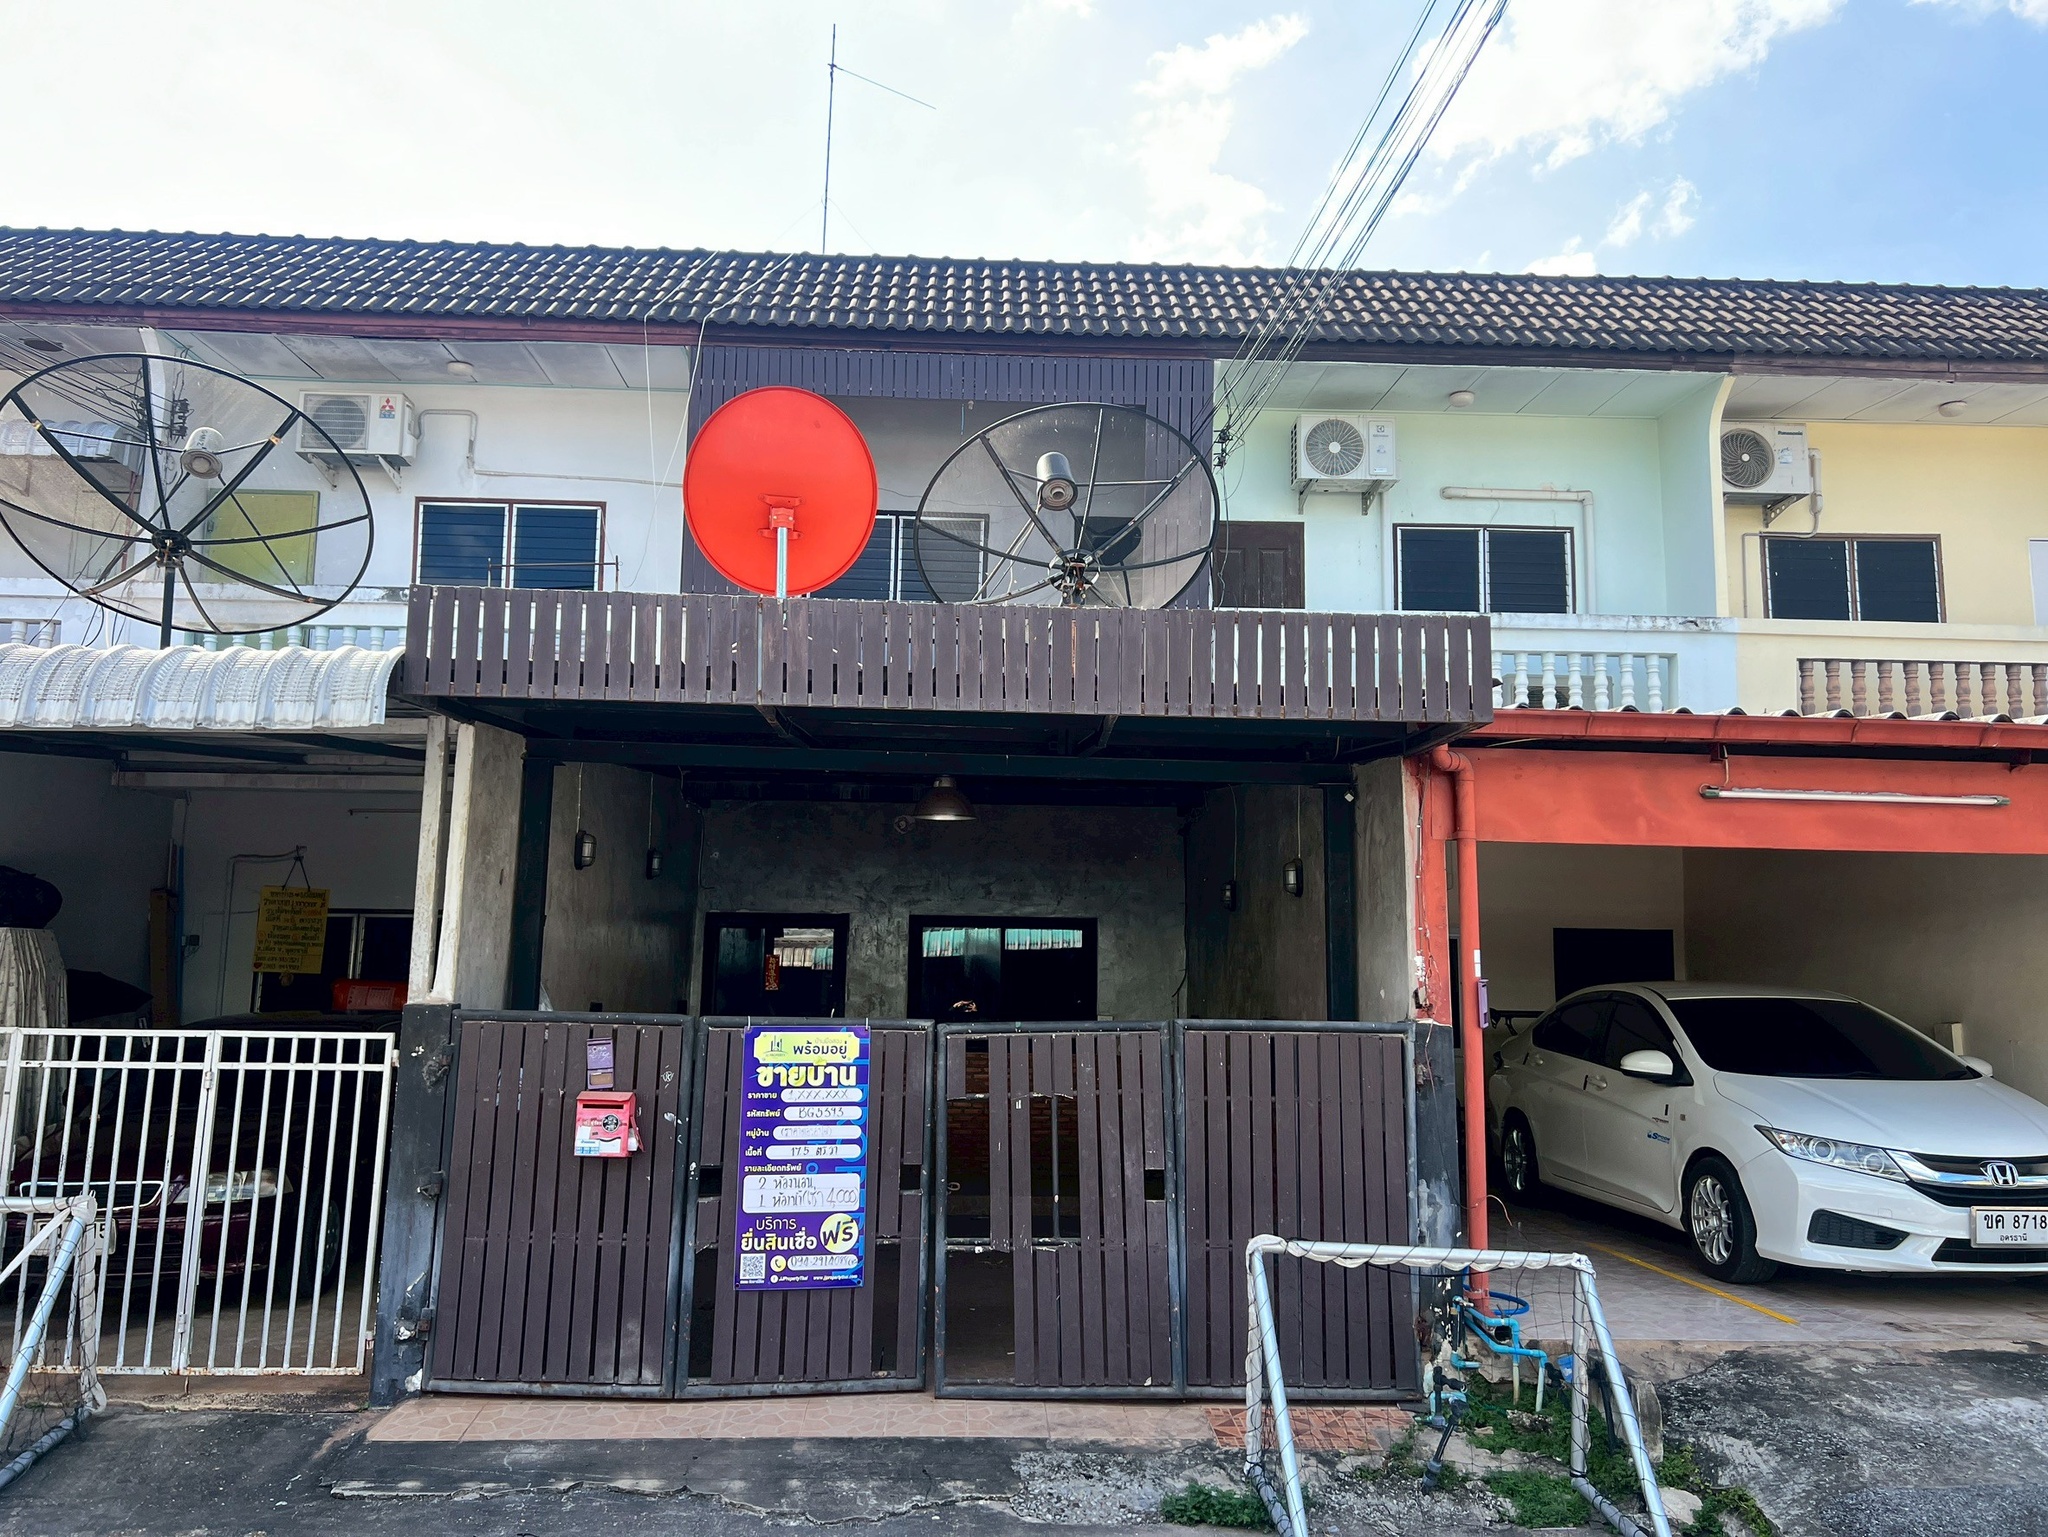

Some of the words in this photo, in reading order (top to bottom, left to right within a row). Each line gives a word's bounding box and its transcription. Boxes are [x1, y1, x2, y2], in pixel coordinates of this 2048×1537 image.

[793, 1040, 847, 1060] พร้อมอยู่
[756, 1057, 857, 1087] ขายบ้าน
[746, 1108, 781, 1118] รหัสทรัพย์
[745, 1128, 770, 1140] หมู่บ้าน
[744, 1162, 802, 1173] รายละเอียดทรัพย์
[758, 1177, 767, 1190] 2
[759, 1194, 766, 1208] 1
[756, 1216, 797, 1230] บริการ
[1984, 1214, 2005, 1229] ขค
[2012, 1214, 2048, 1230] 8718
[741, 1226, 818, 1251] ยื่นสินเชื่อ
[822, 1217, 854, 1247] ฟรี
[2000, 1233, 2028, 1243] อุดรธานี
